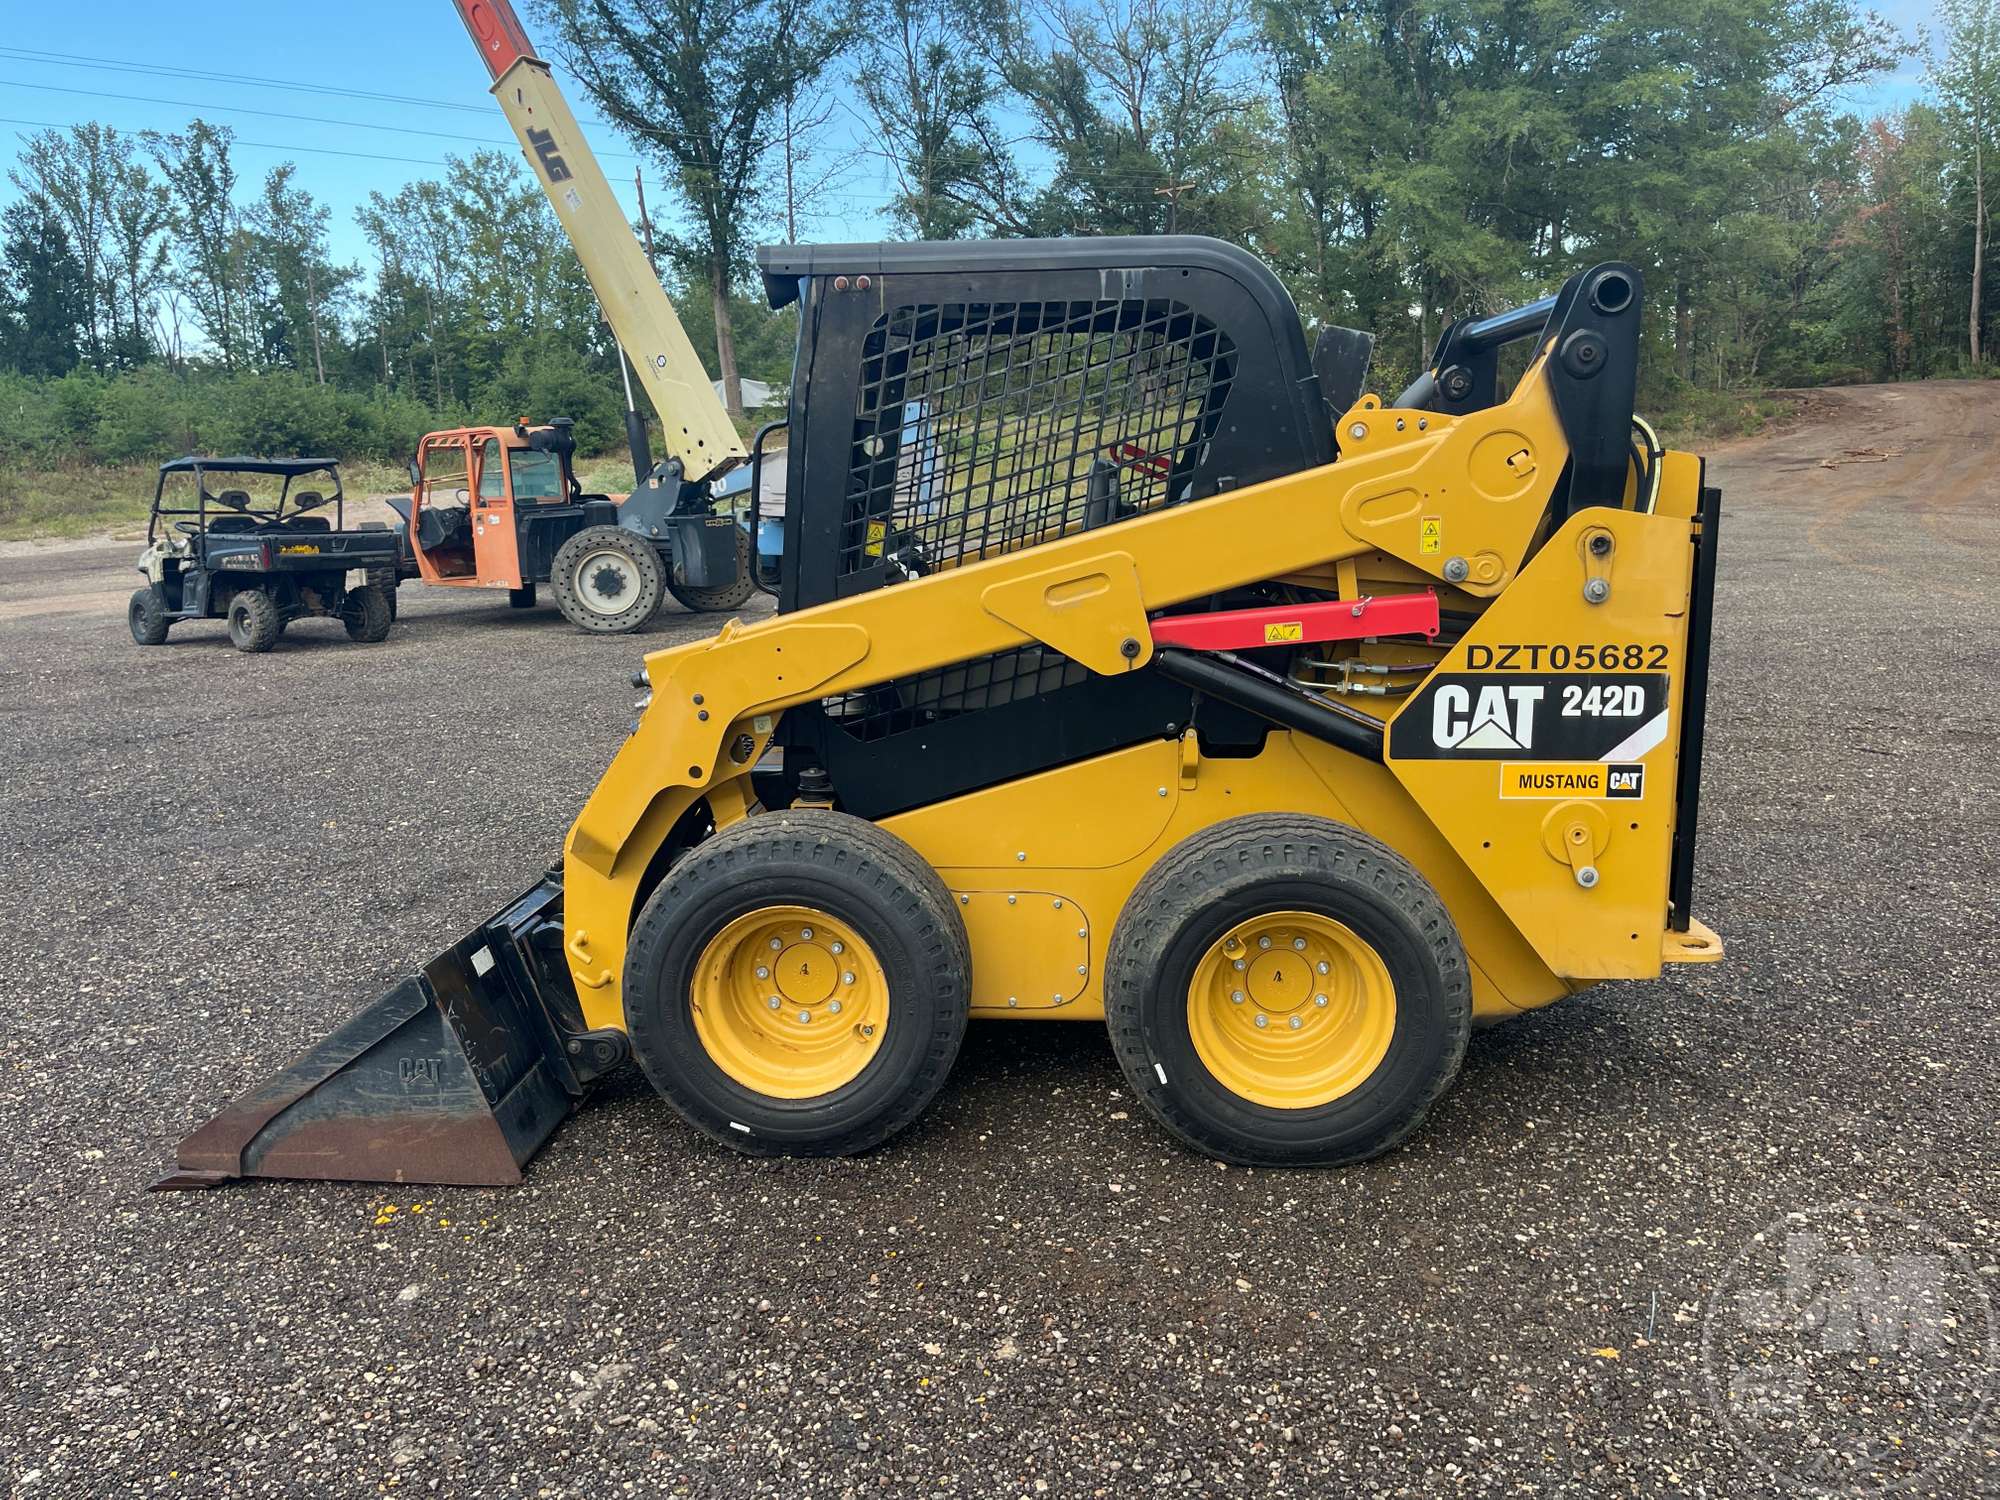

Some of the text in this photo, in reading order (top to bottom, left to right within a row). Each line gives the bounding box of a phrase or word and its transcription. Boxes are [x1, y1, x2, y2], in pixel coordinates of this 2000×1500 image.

[526, 127, 573, 183] JLG
[1466, 645, 1669, 670] DZT05682
[1433, 685, 1544, 750] CAT
[1562, 686, 1645, 717] 242D
[1519, 773, 1641, 790] MUSTANG CAT
[399, 1058, 441, 1086] CAT
